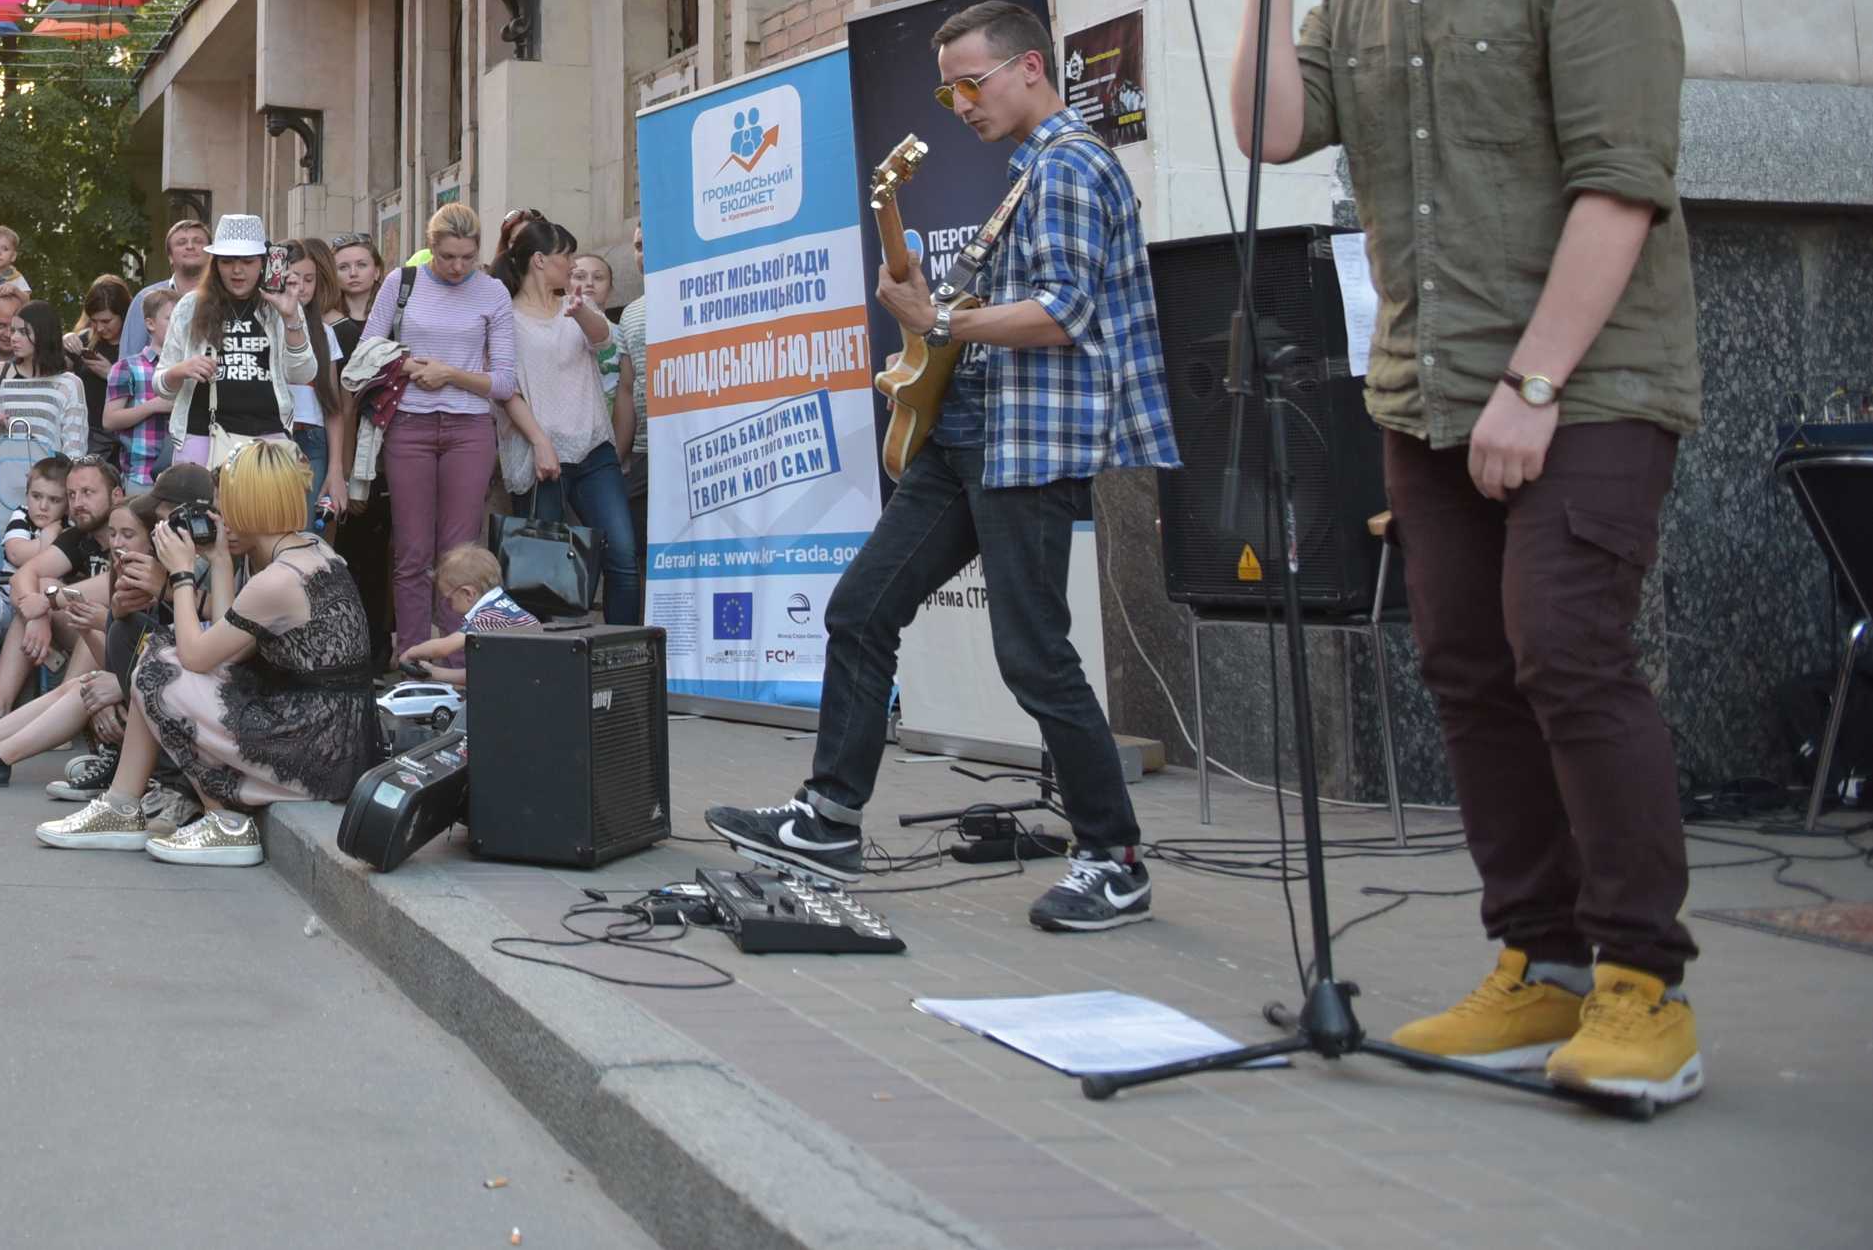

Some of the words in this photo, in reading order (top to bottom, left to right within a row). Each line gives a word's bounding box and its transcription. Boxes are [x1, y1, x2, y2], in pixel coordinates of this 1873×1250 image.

[702, 163, 794, 206] ГРОМАДСЬКИЙ
[719, 188, 776, 215] БЮДЖЕТ
[679, 271, 725, 301] ПРОЕКТ
[727, 253, 785, 289] МІСЬКОЇ
[786, 247, 830, 278] РАДИ
[683, 306, 697, 327] М.
[699, 278, 827, 324] КРОПИВНИЦЬКОГО
[222, 319, 253, 334] EAT
[222, 336, 270, 352] SLEEP
[224, 352, 258, 367] EFIR
[689, 444, 703, 466] НЕ
[705, 432, 737, 460] БУДЬ
[738, 400, 820, 445] БАЙДУЖИМ
[690, 470, 701, 485] ДО
[701, 448, 759, 481] МАЙБУТНЬОГО
[760, 437, 783, 460] ТВОГО
[784, 427, 823, 448] МІСТА.
[693, 475, 738, 511] ТВОРИ
[742, 460, 778, 493] ЙОГО
[781, 447, 825, 479] САМ
[653, 551, 697, 570] Деталі
[699, 553, 721, 567] на:
[765, 649, 796, 664] FCM
